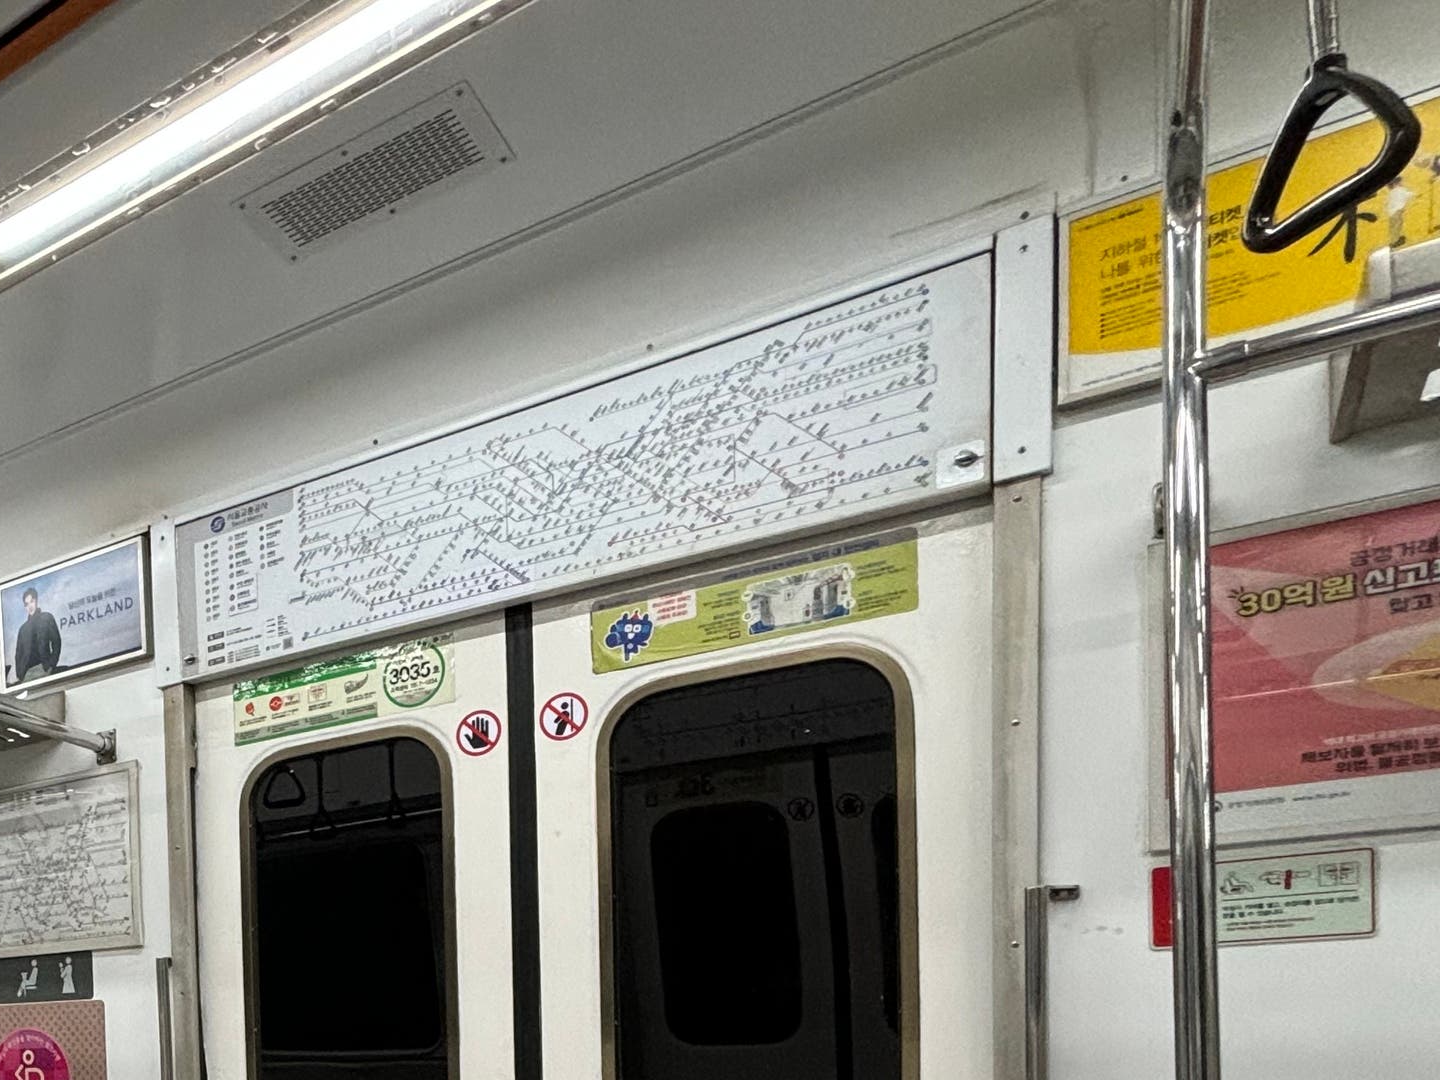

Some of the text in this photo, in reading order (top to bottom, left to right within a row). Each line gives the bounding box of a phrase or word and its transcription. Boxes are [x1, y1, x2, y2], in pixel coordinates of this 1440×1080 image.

[1236, 579, 1315, 618] 30억
[1320, 573, 1356, 603] 원
[59, 597, 134, 630] PARKLAND
[389, 661, 431, 685] 3035
